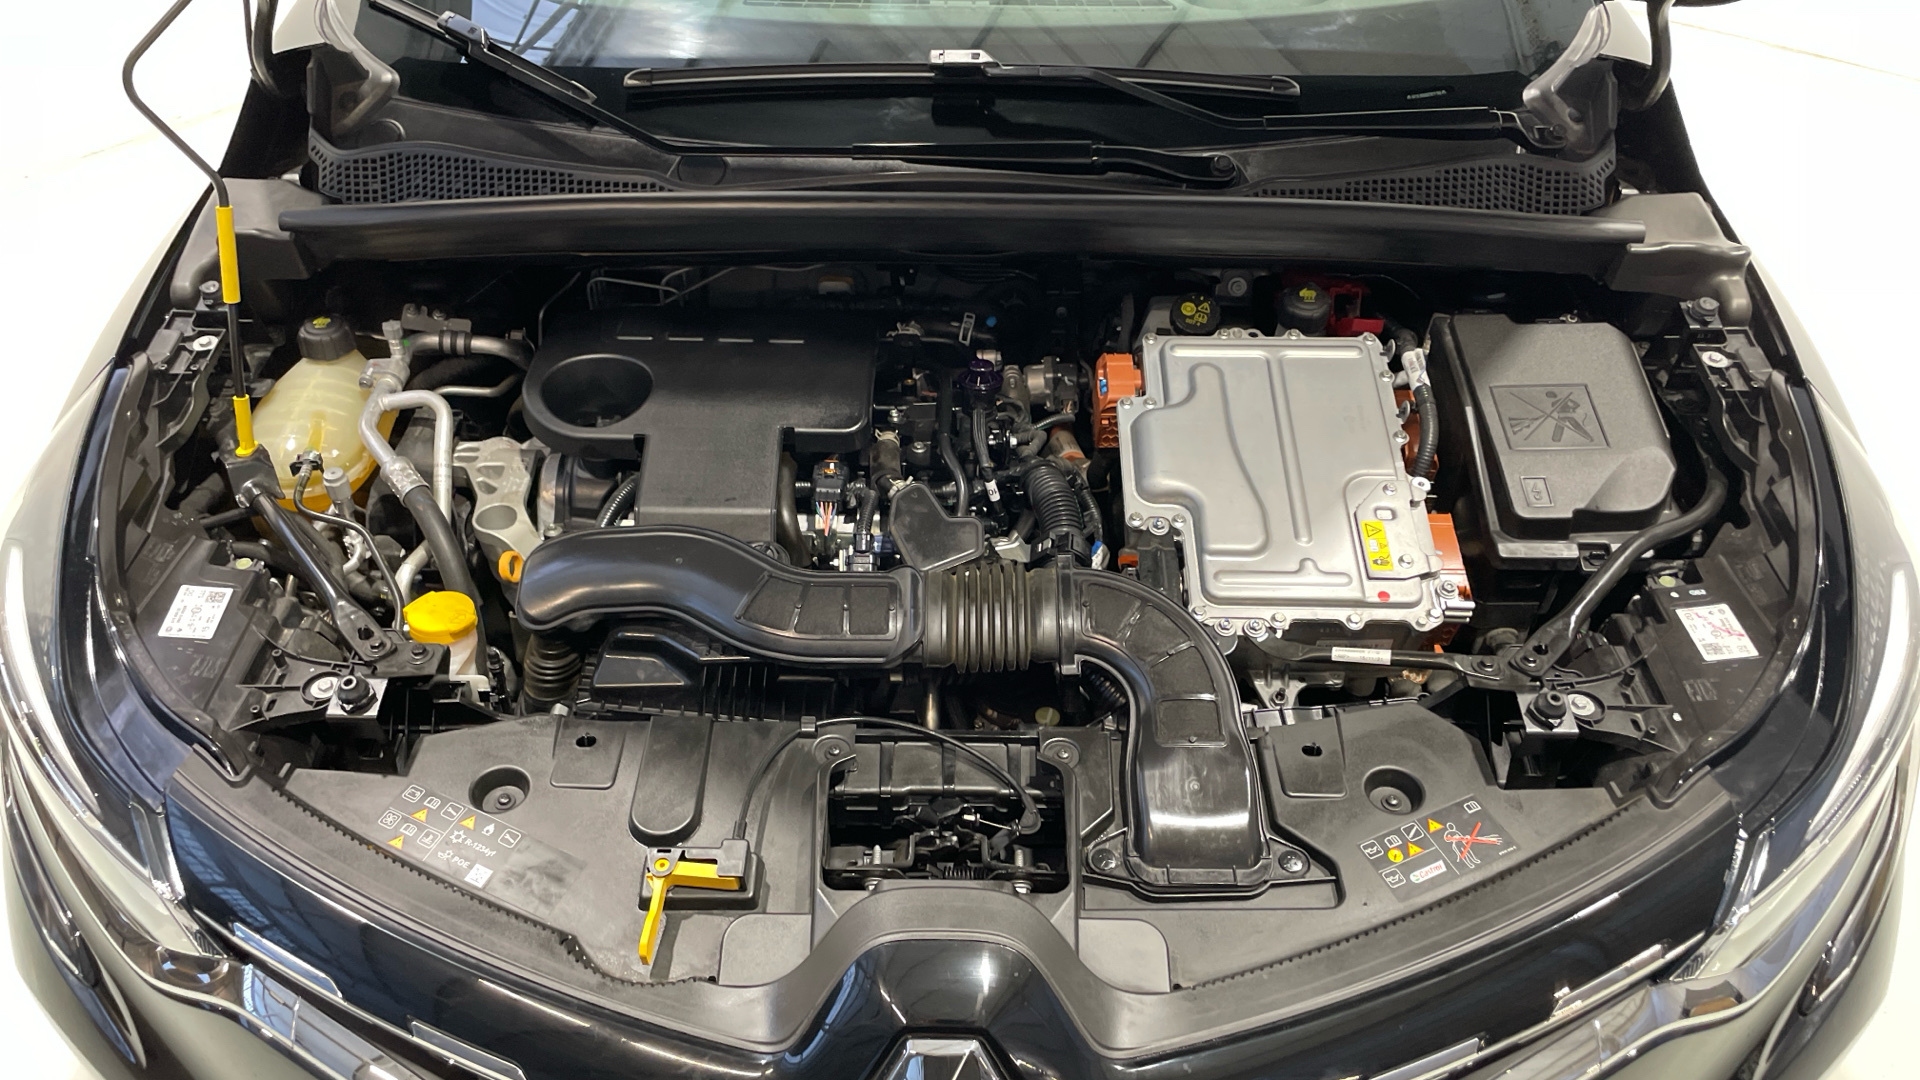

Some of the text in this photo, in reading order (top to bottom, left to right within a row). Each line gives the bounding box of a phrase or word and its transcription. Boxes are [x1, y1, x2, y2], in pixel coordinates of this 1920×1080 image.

[464, 838, 497, 857] R-1234yf
[451, 856, 471, 869] POE
[1419, 863, 1443, 879] Castrol
